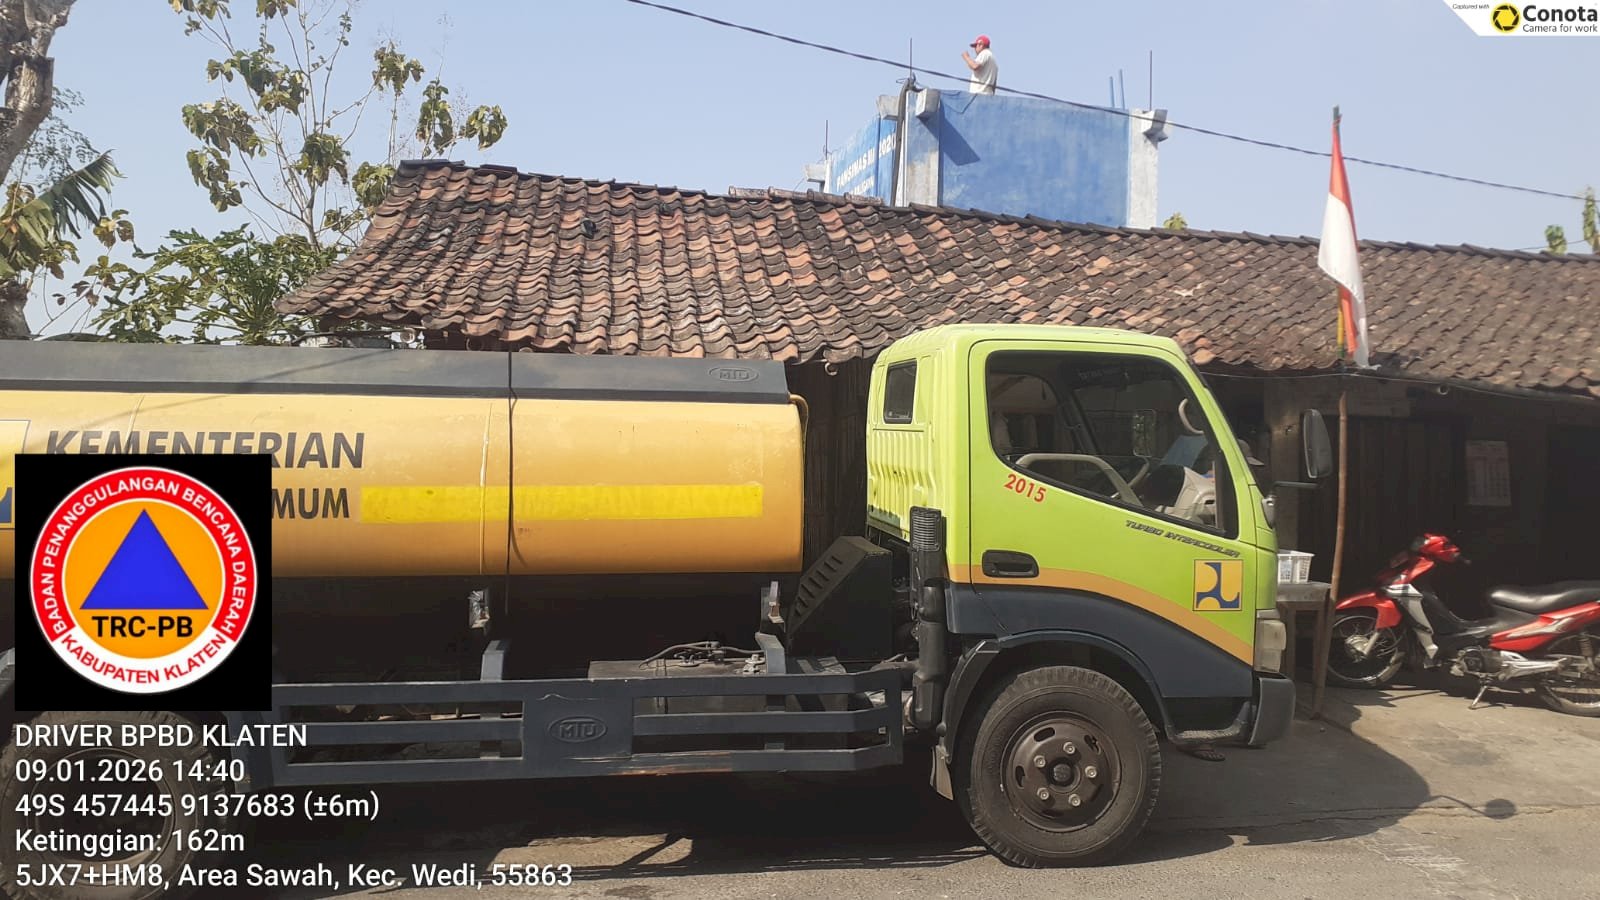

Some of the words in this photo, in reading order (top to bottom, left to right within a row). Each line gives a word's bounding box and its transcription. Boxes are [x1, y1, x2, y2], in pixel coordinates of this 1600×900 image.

[46, 431, 365, 469] KEMENTERIAN
[1003, 473, 1047, 503] 2015
[272, 488, 350, 519] MUM
[1125, 520, 1165, 536] TURBO
